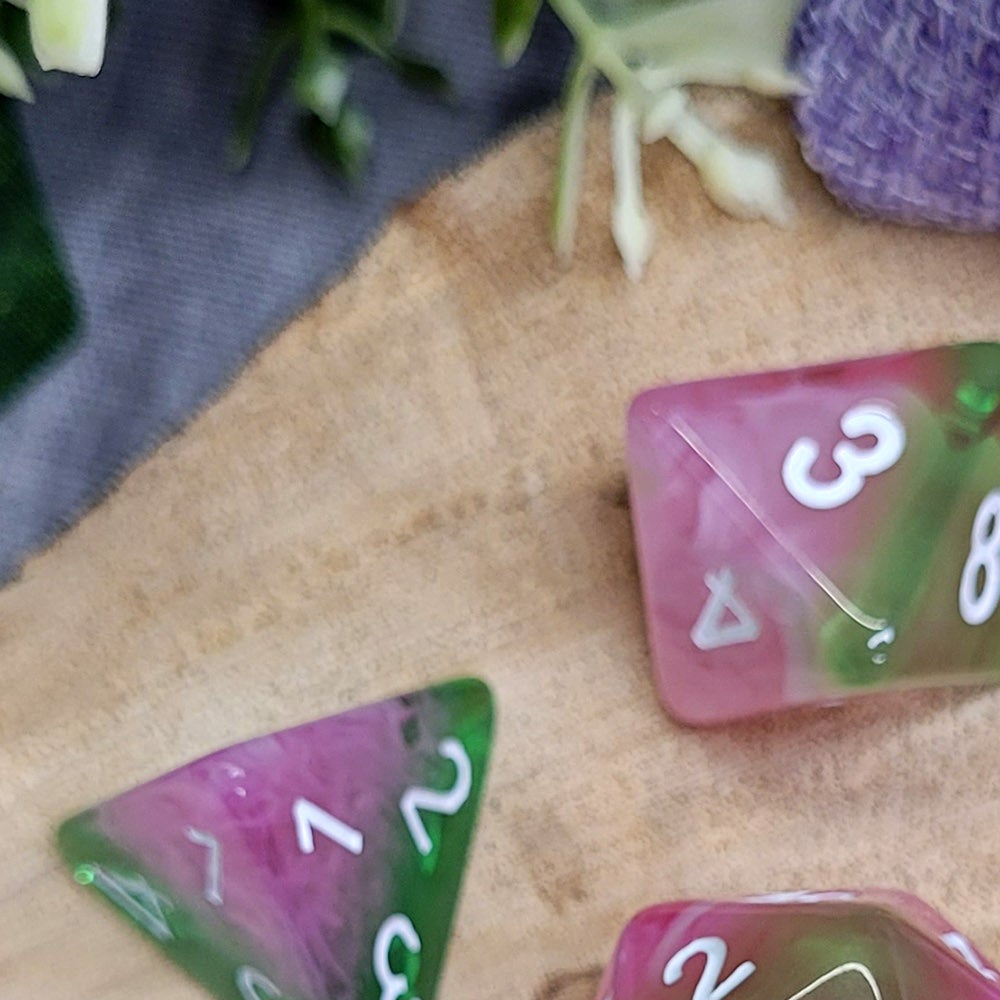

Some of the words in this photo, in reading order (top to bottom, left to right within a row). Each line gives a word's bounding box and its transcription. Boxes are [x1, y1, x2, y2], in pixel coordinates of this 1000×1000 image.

[782, 403, 907, 509] 3
[691, 566, 759, 650] 4
[293, 798, 364, 855] 1
[401, 737, 472, 856] 2
